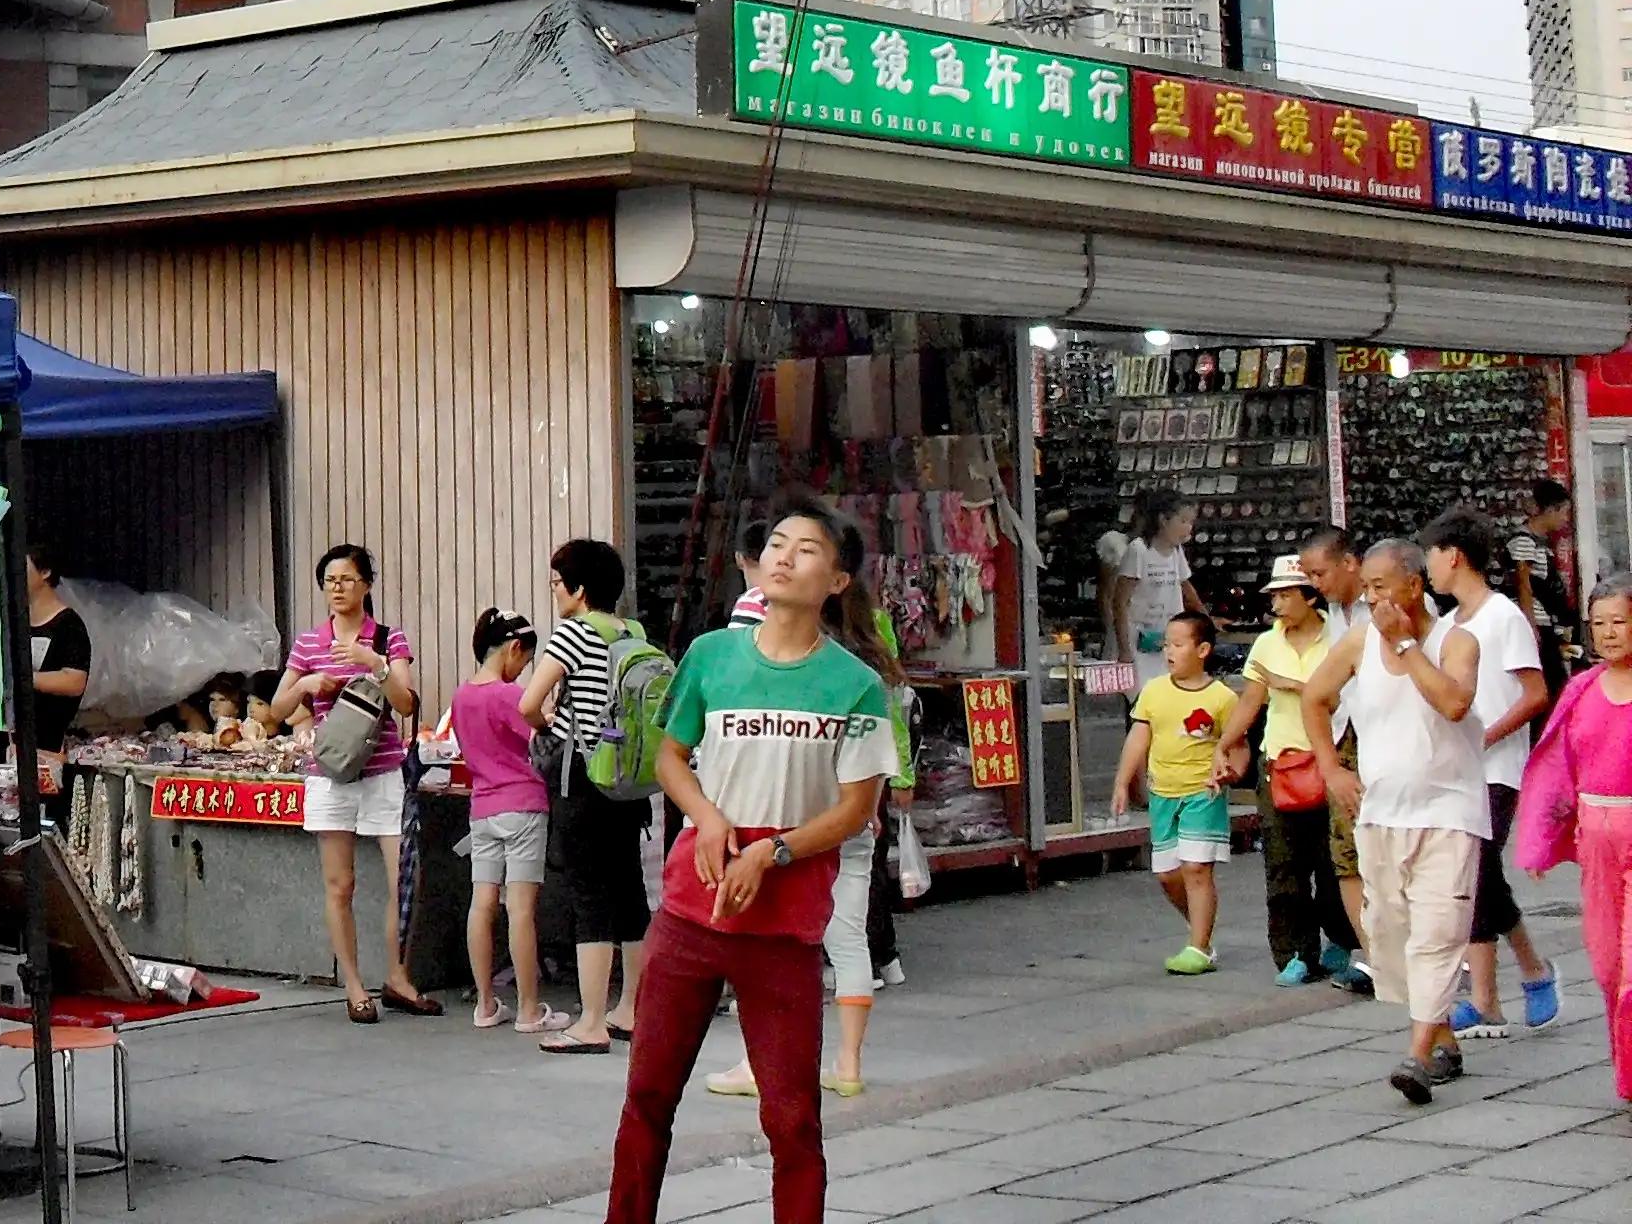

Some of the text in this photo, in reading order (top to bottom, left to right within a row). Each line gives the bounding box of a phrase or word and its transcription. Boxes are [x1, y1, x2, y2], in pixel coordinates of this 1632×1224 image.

[748, 10, 1125, 124] 望远镜鱼杆商行
[1149, 79, 1421, 170] 望远镜专营
[1148, 150, 1204, 172] магазин
[722, 713, 879, 741] Fashion XTEP
